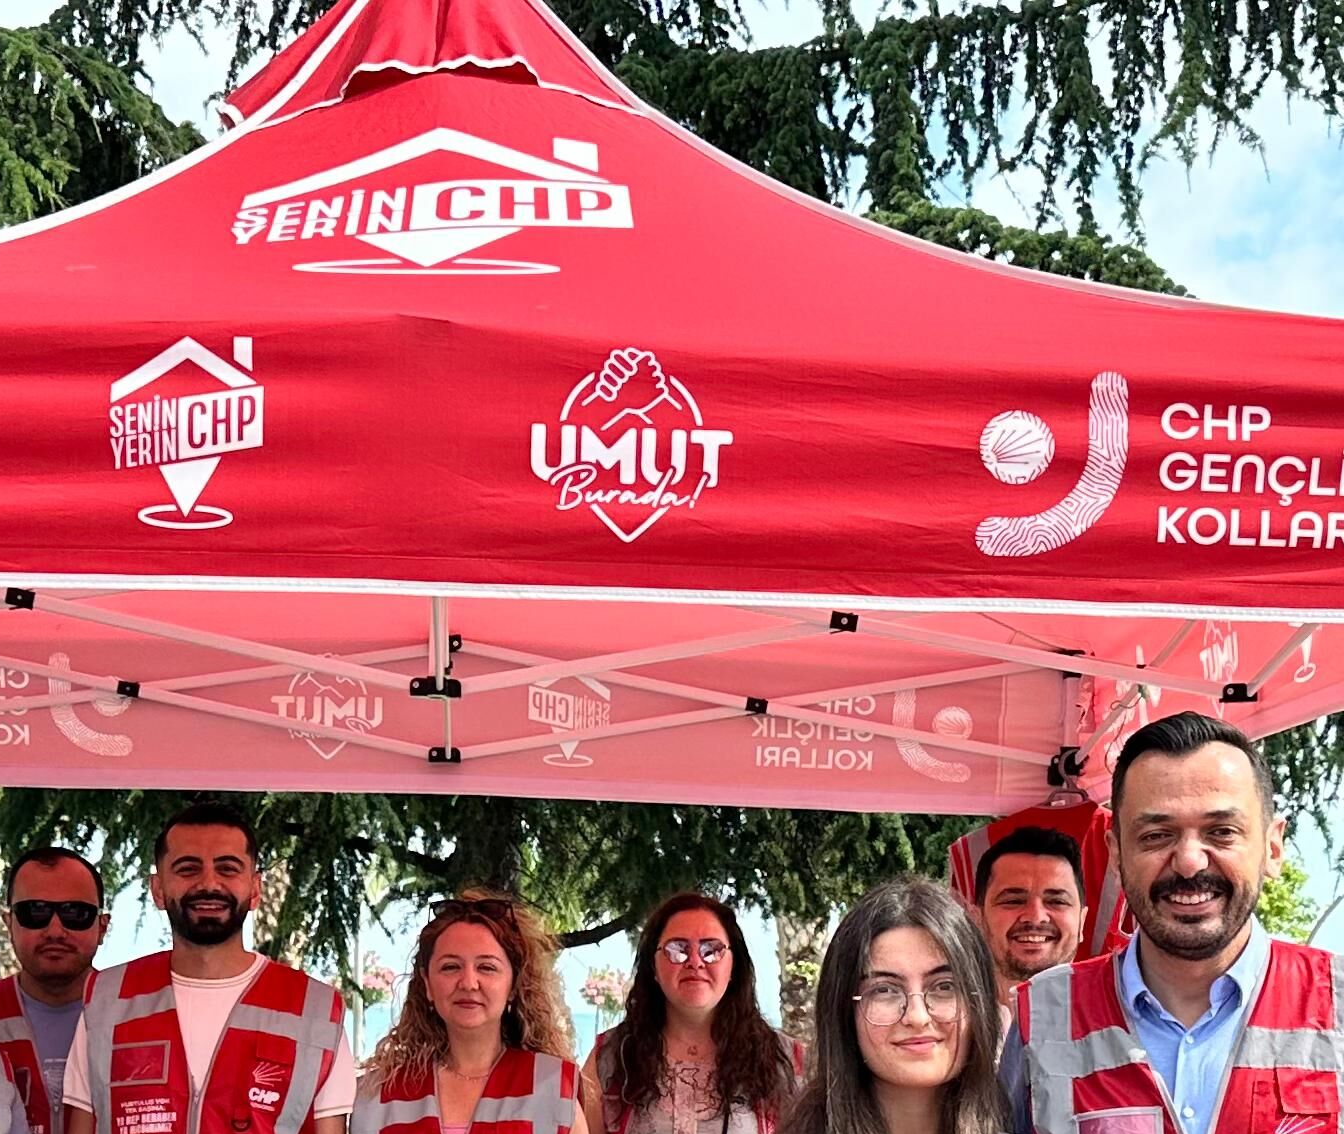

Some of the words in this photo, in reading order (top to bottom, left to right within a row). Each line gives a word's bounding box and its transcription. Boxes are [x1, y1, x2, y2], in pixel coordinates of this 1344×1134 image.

[435, 185, 613, 221] CHP
[232, 208, 405, 244] YERİN
[109, 394, 177, 437] SENİN
[188, 395, 256, 449] CHP
[1160, 402, 1271, 441] CHP
[110, 425, 177, 470] YERİN
[530, 422, 734, 488] UMUT
[550, 464, 708, 511] Burada!
